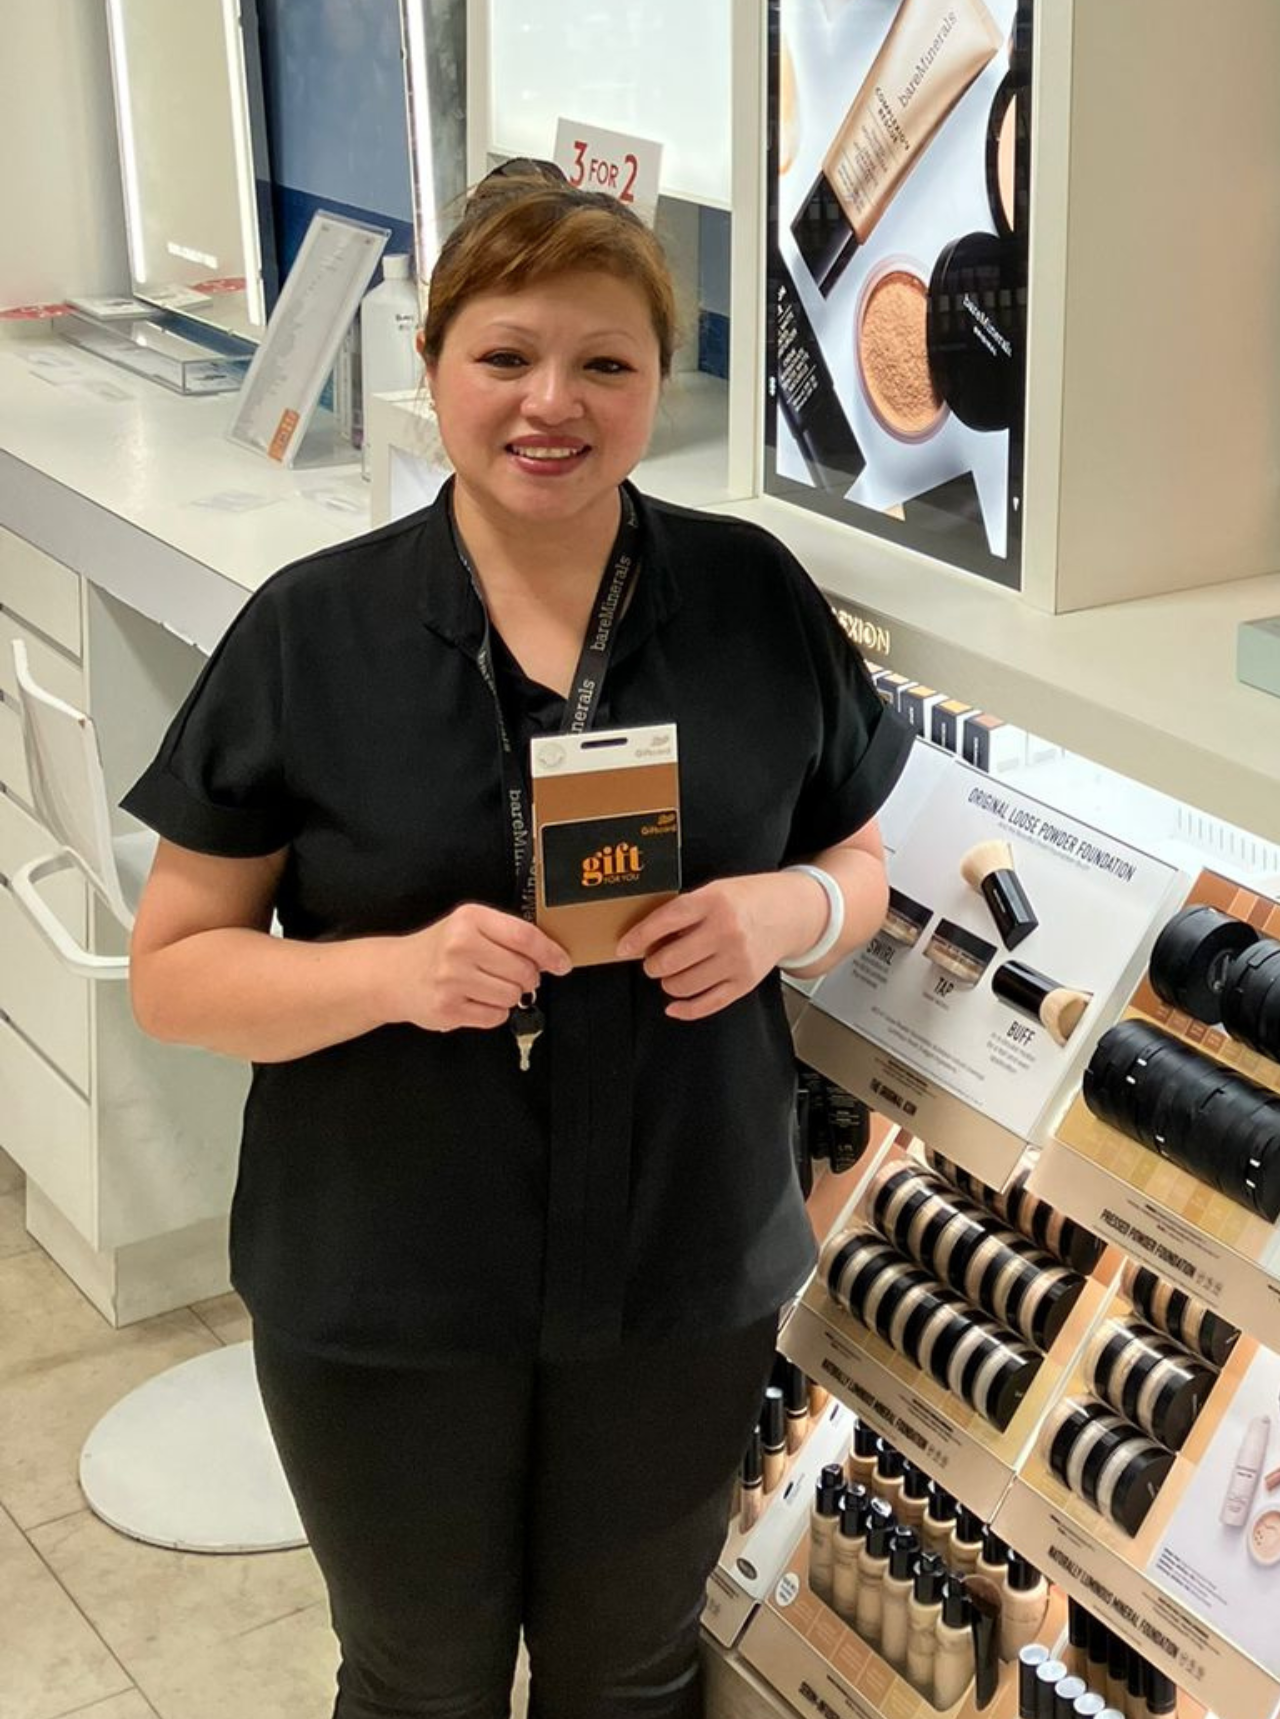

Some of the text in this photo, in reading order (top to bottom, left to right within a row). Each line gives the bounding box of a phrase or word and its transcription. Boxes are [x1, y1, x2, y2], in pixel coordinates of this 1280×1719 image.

[897, 11, 958, 109] bareMinerals
[569, 140, 638, 203] 3 FOR 2
[590, 555, 632, 651] bareMinerals
[581, 842, 645, 887] gift
[967, 787, 1009, 819] ORIGINAL
[1008, 807, 1041, 834] LOOSE
[1038, 821, 1079, 852] POWDER
[1075, 839, 1137, 883] FOUNDATION
[866, 938, 896, 965] SWIRL
[934, 977, 954, 997] TAP
[1006, 1021, 1036, 1046] BUFF
[1101, 1208, 1131, 1236] PRESSED
[1128, 1227, 1158, 1253] POWDER
[1155, 1243, 1197, 1278] FOUNDATION
